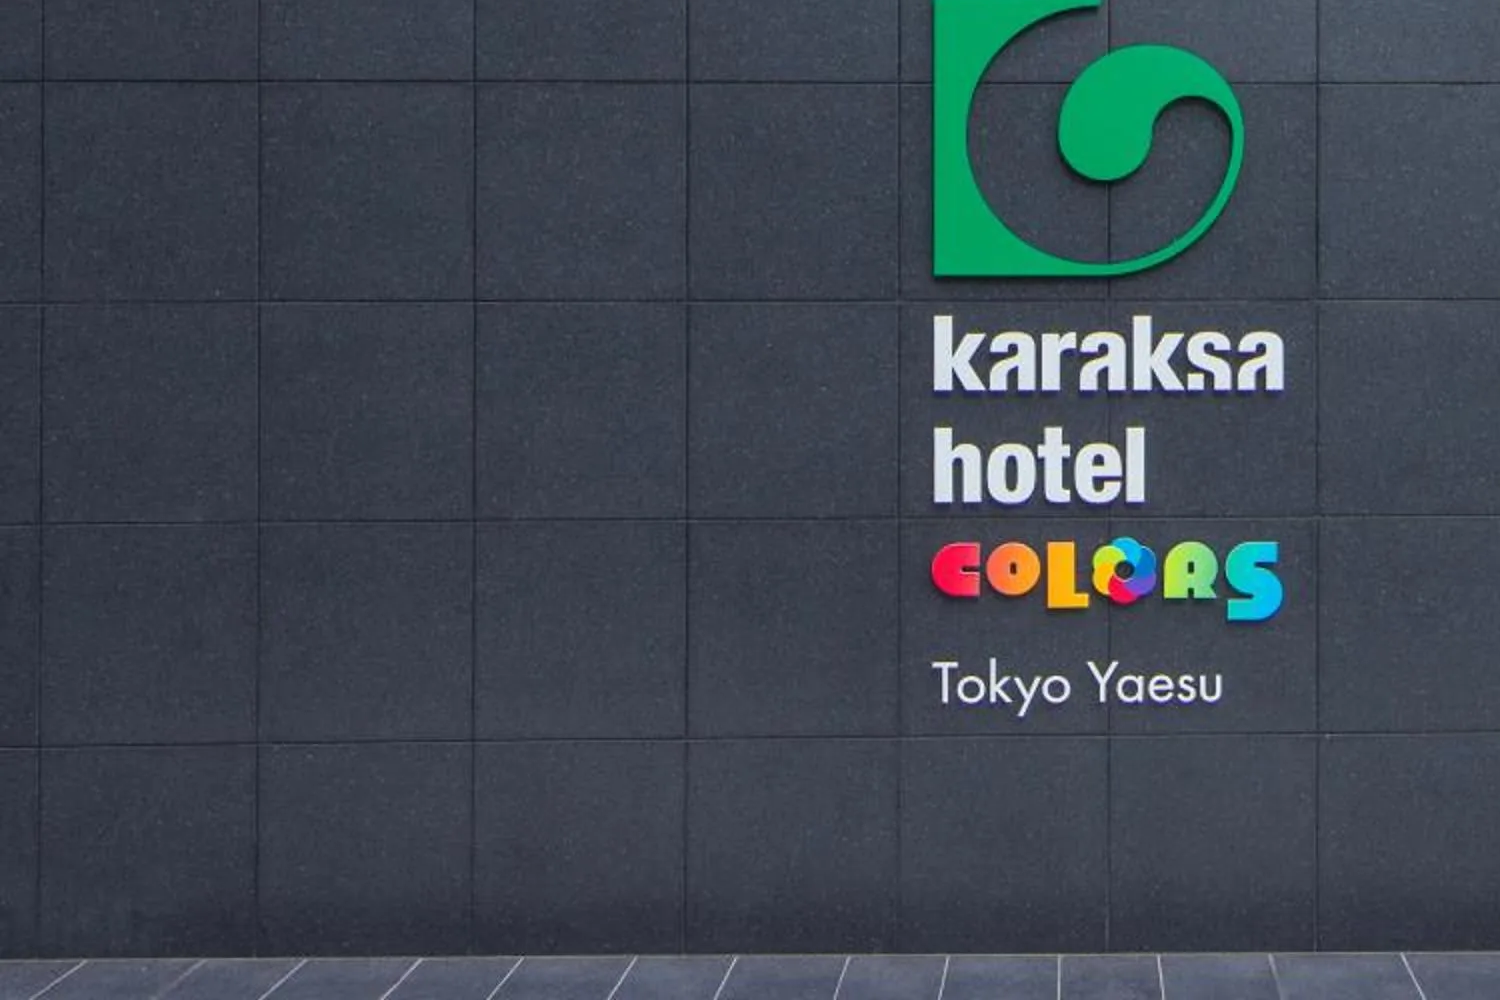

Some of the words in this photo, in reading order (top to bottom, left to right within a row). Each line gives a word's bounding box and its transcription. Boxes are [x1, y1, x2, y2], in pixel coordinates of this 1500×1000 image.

[933, 315, 1285, 391] karaksa
[933, 427, 1146, 504] hotel
[931, 536, 1284, 622] COLORS
[931, 657, 1072, 718] Tokyo
[1087, 659, 1223, 703] Yaesu
